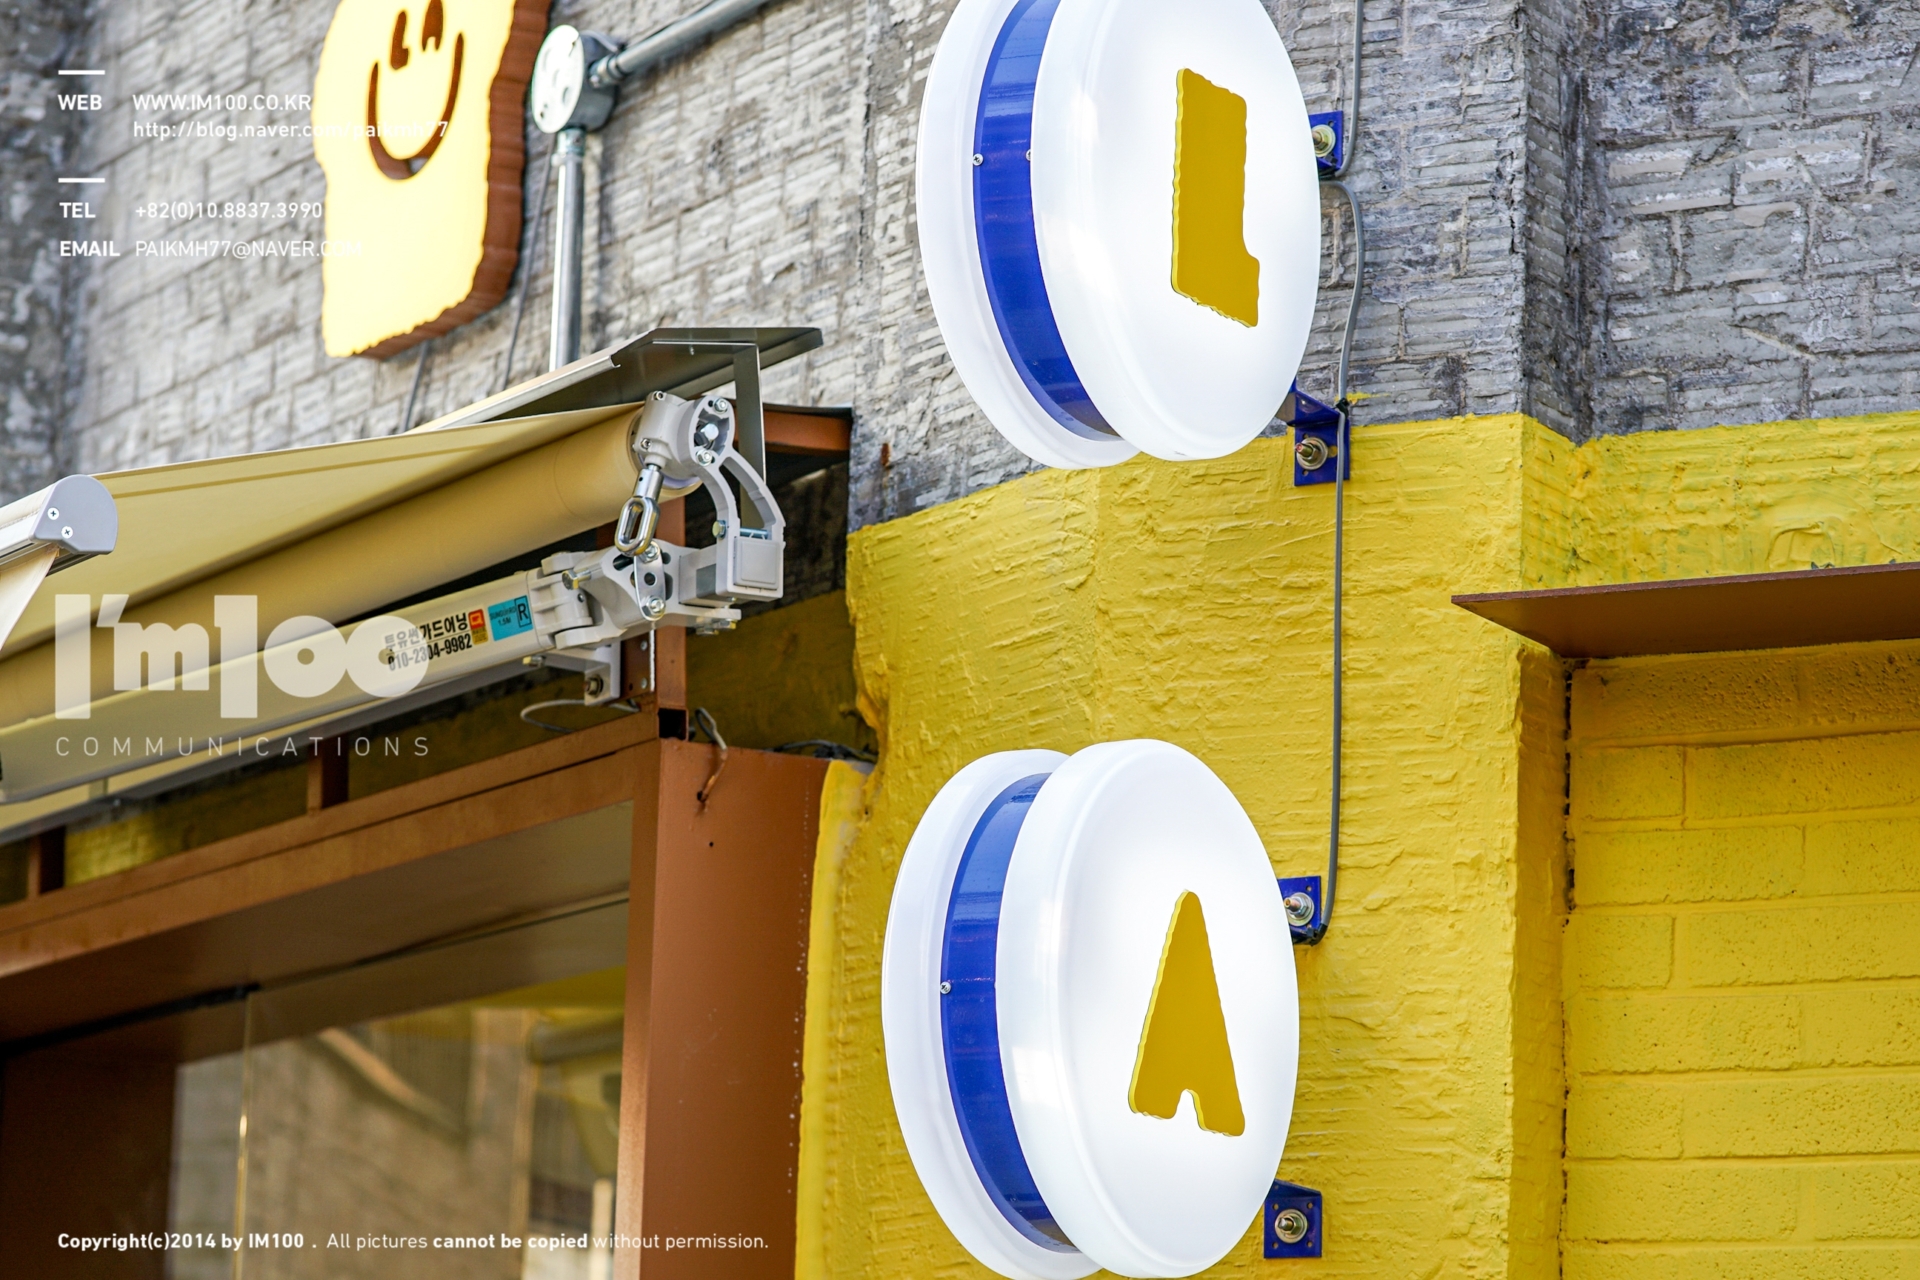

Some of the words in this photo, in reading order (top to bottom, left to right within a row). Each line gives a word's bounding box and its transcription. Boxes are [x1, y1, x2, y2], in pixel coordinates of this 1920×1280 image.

[1170, 67, 1260, 328] L
[387, 633, 473, 671] 010-2304-9982
[1128, 889, 1245, 1137] A
